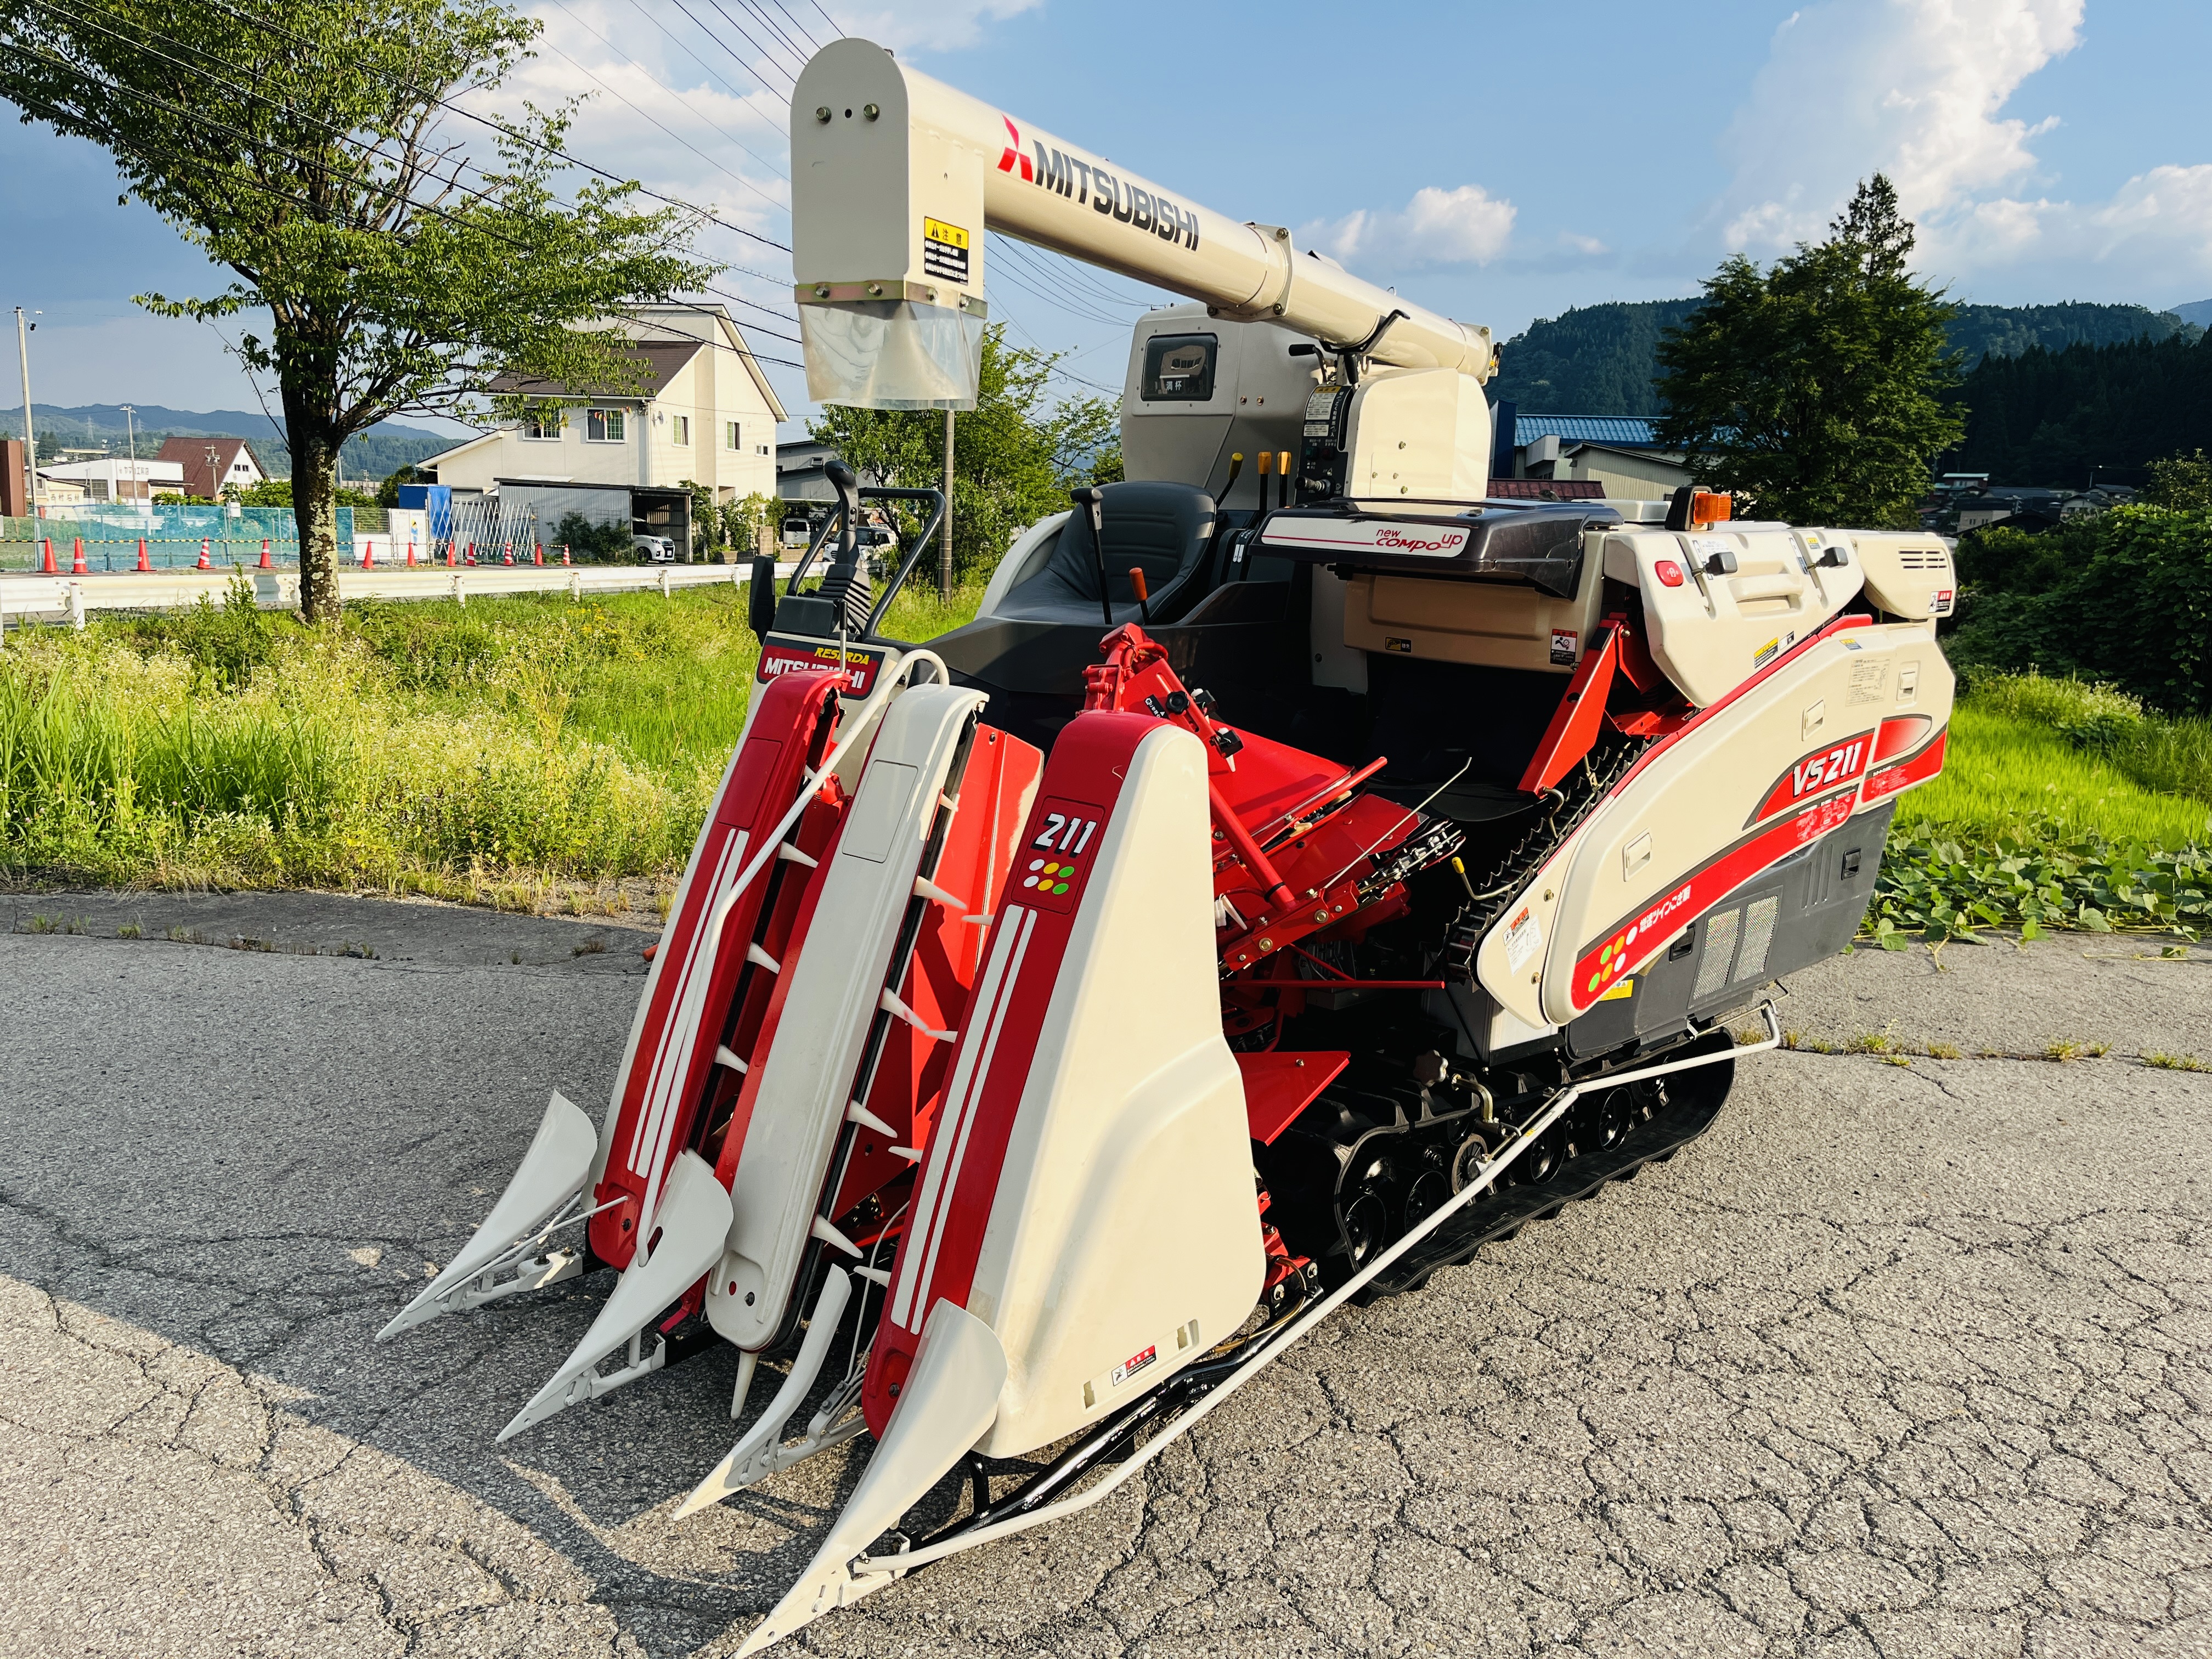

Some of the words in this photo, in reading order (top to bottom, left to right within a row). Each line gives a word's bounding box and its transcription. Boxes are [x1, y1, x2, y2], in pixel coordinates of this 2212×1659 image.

[1032, 139, 1199, 252] MITSUBISHI
[1376, 529, 1401, 538] new
[1793, 742, 1863, 798] VS211
[1034, 813, 1097, 856] 211
